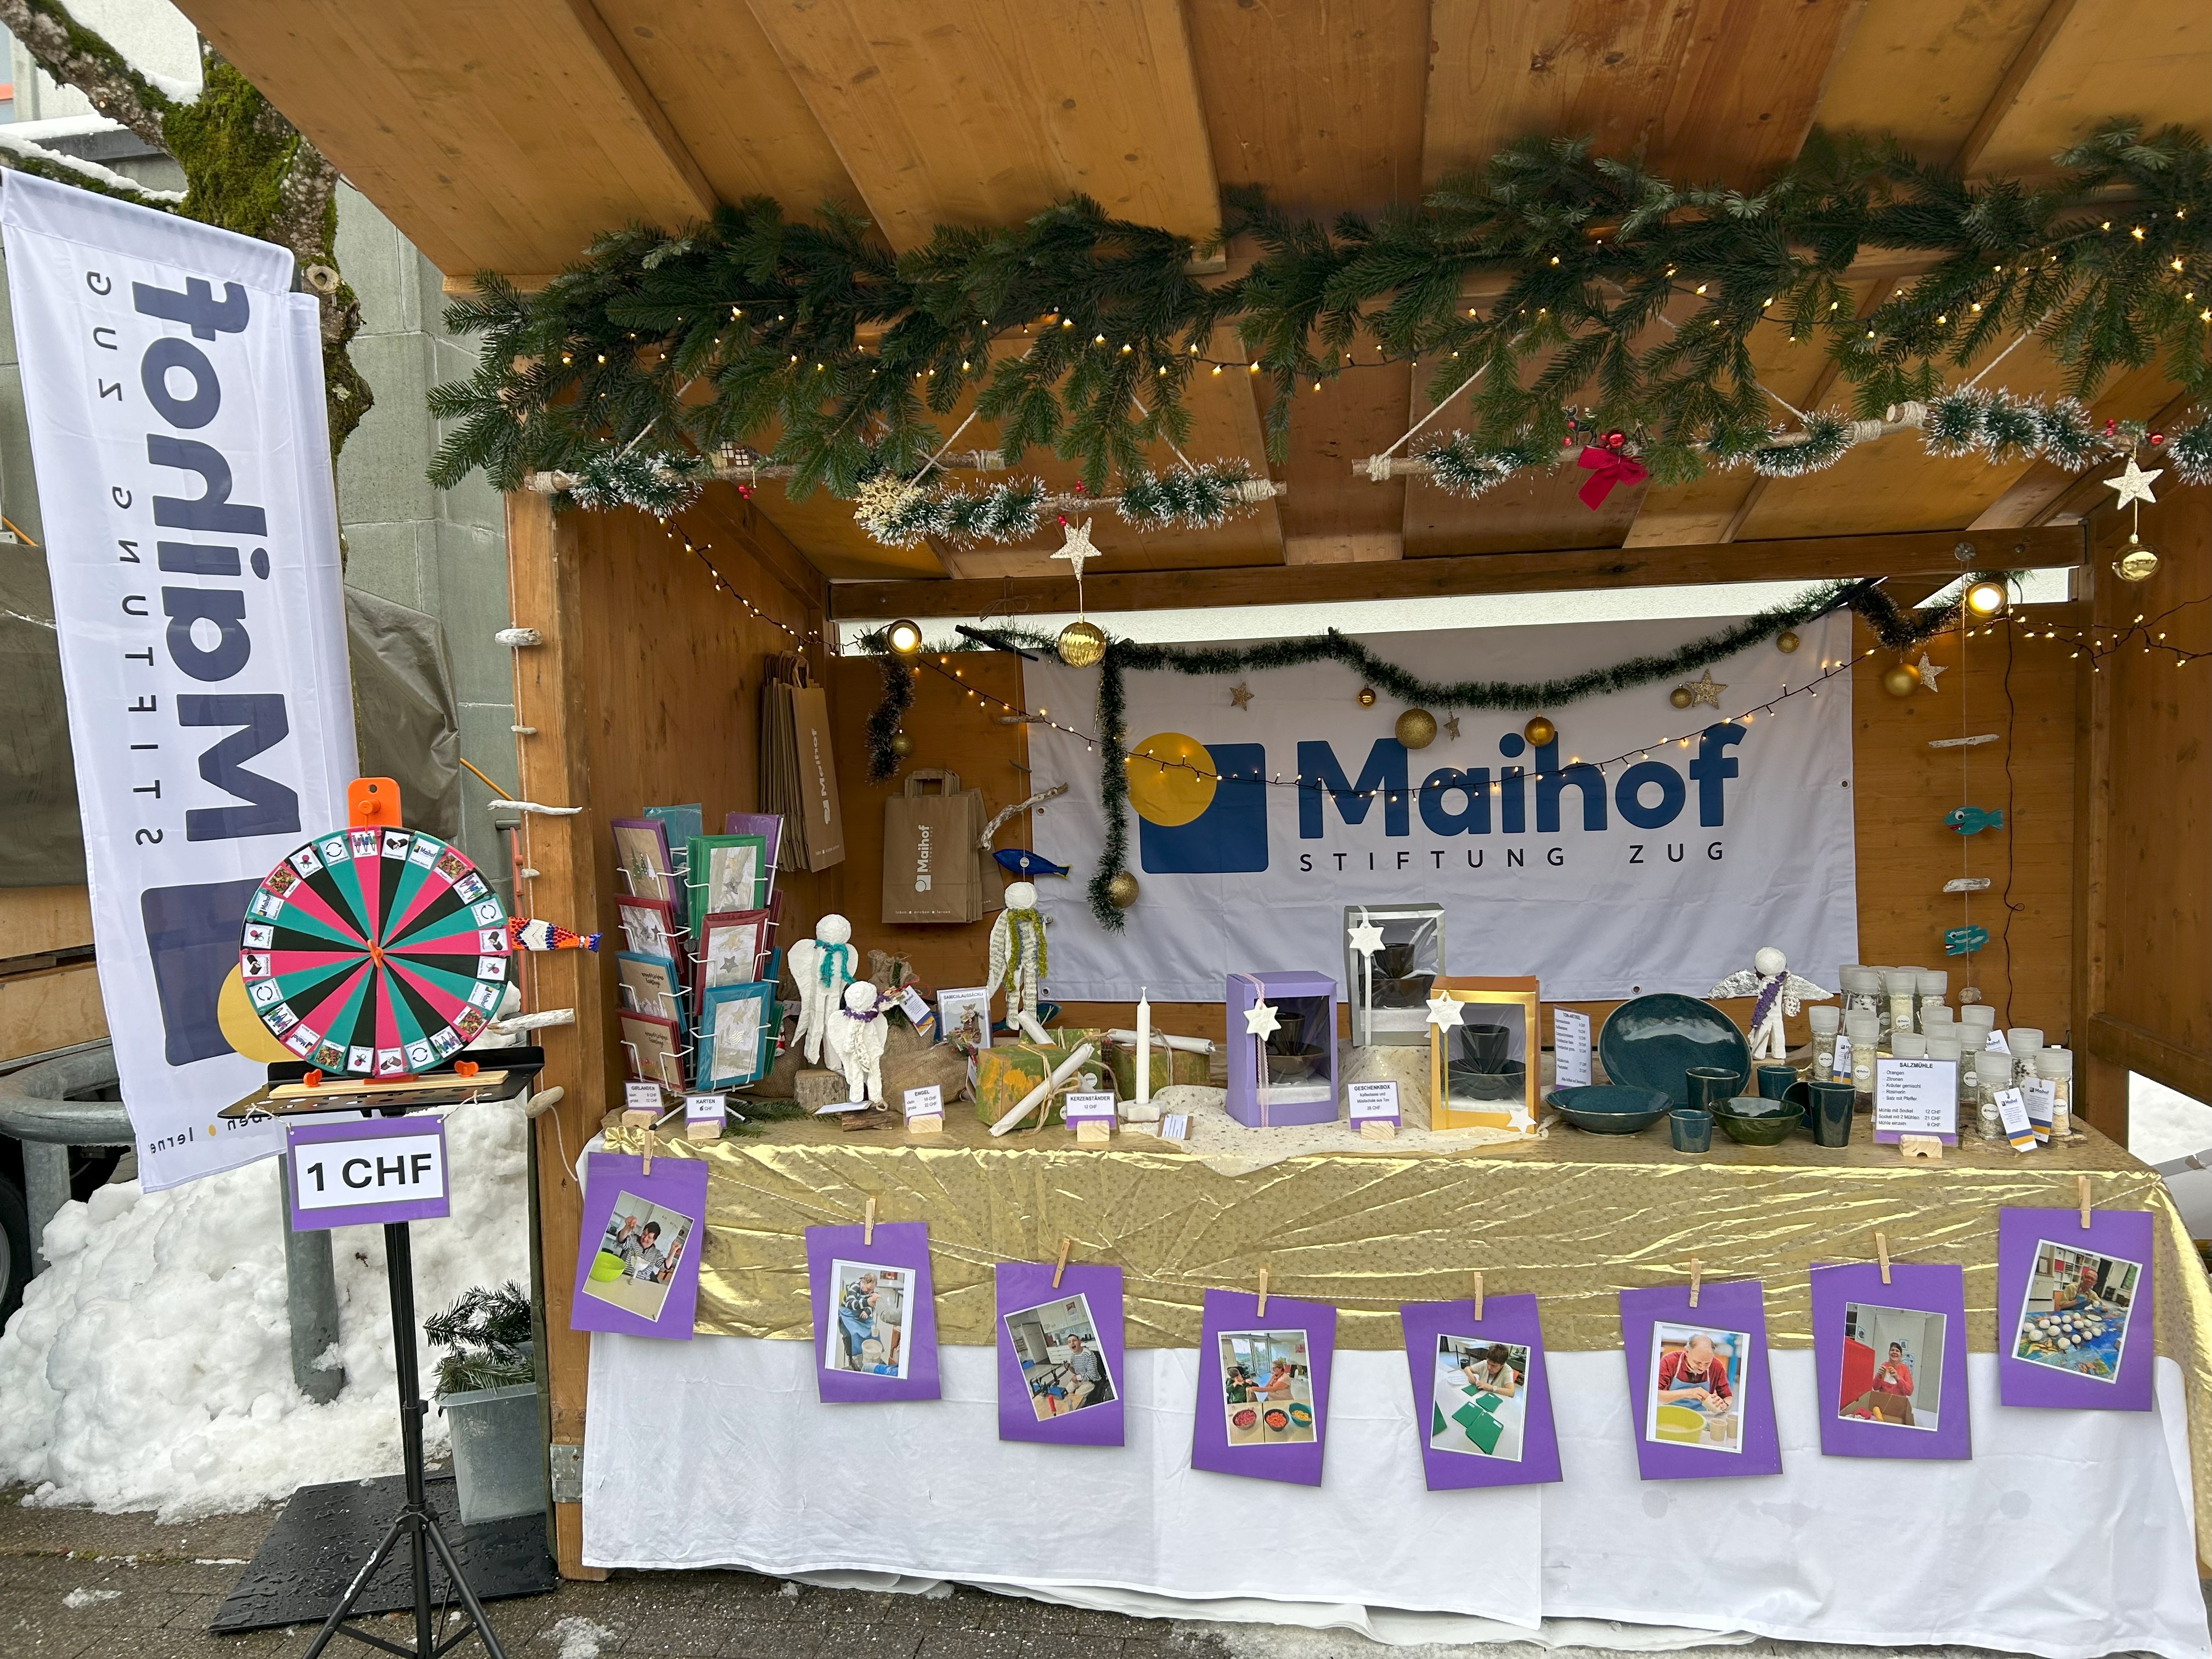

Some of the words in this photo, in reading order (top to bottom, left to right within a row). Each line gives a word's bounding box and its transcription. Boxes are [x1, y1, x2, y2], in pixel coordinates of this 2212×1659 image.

[1297, 721, 1748, 839] Maihof
[419, 846, 436, 858] Maihof
[917, 825, 929, 872] Maihof
[1300, 847, 1566, 873] STIFTUNG
[1629, 841, 1726, 865] ZUG
[290, 1032, 307, 1047] Maihof
[307, 1162, 325, 1192] 1
[342, 1153, 432, 1188] CHF
